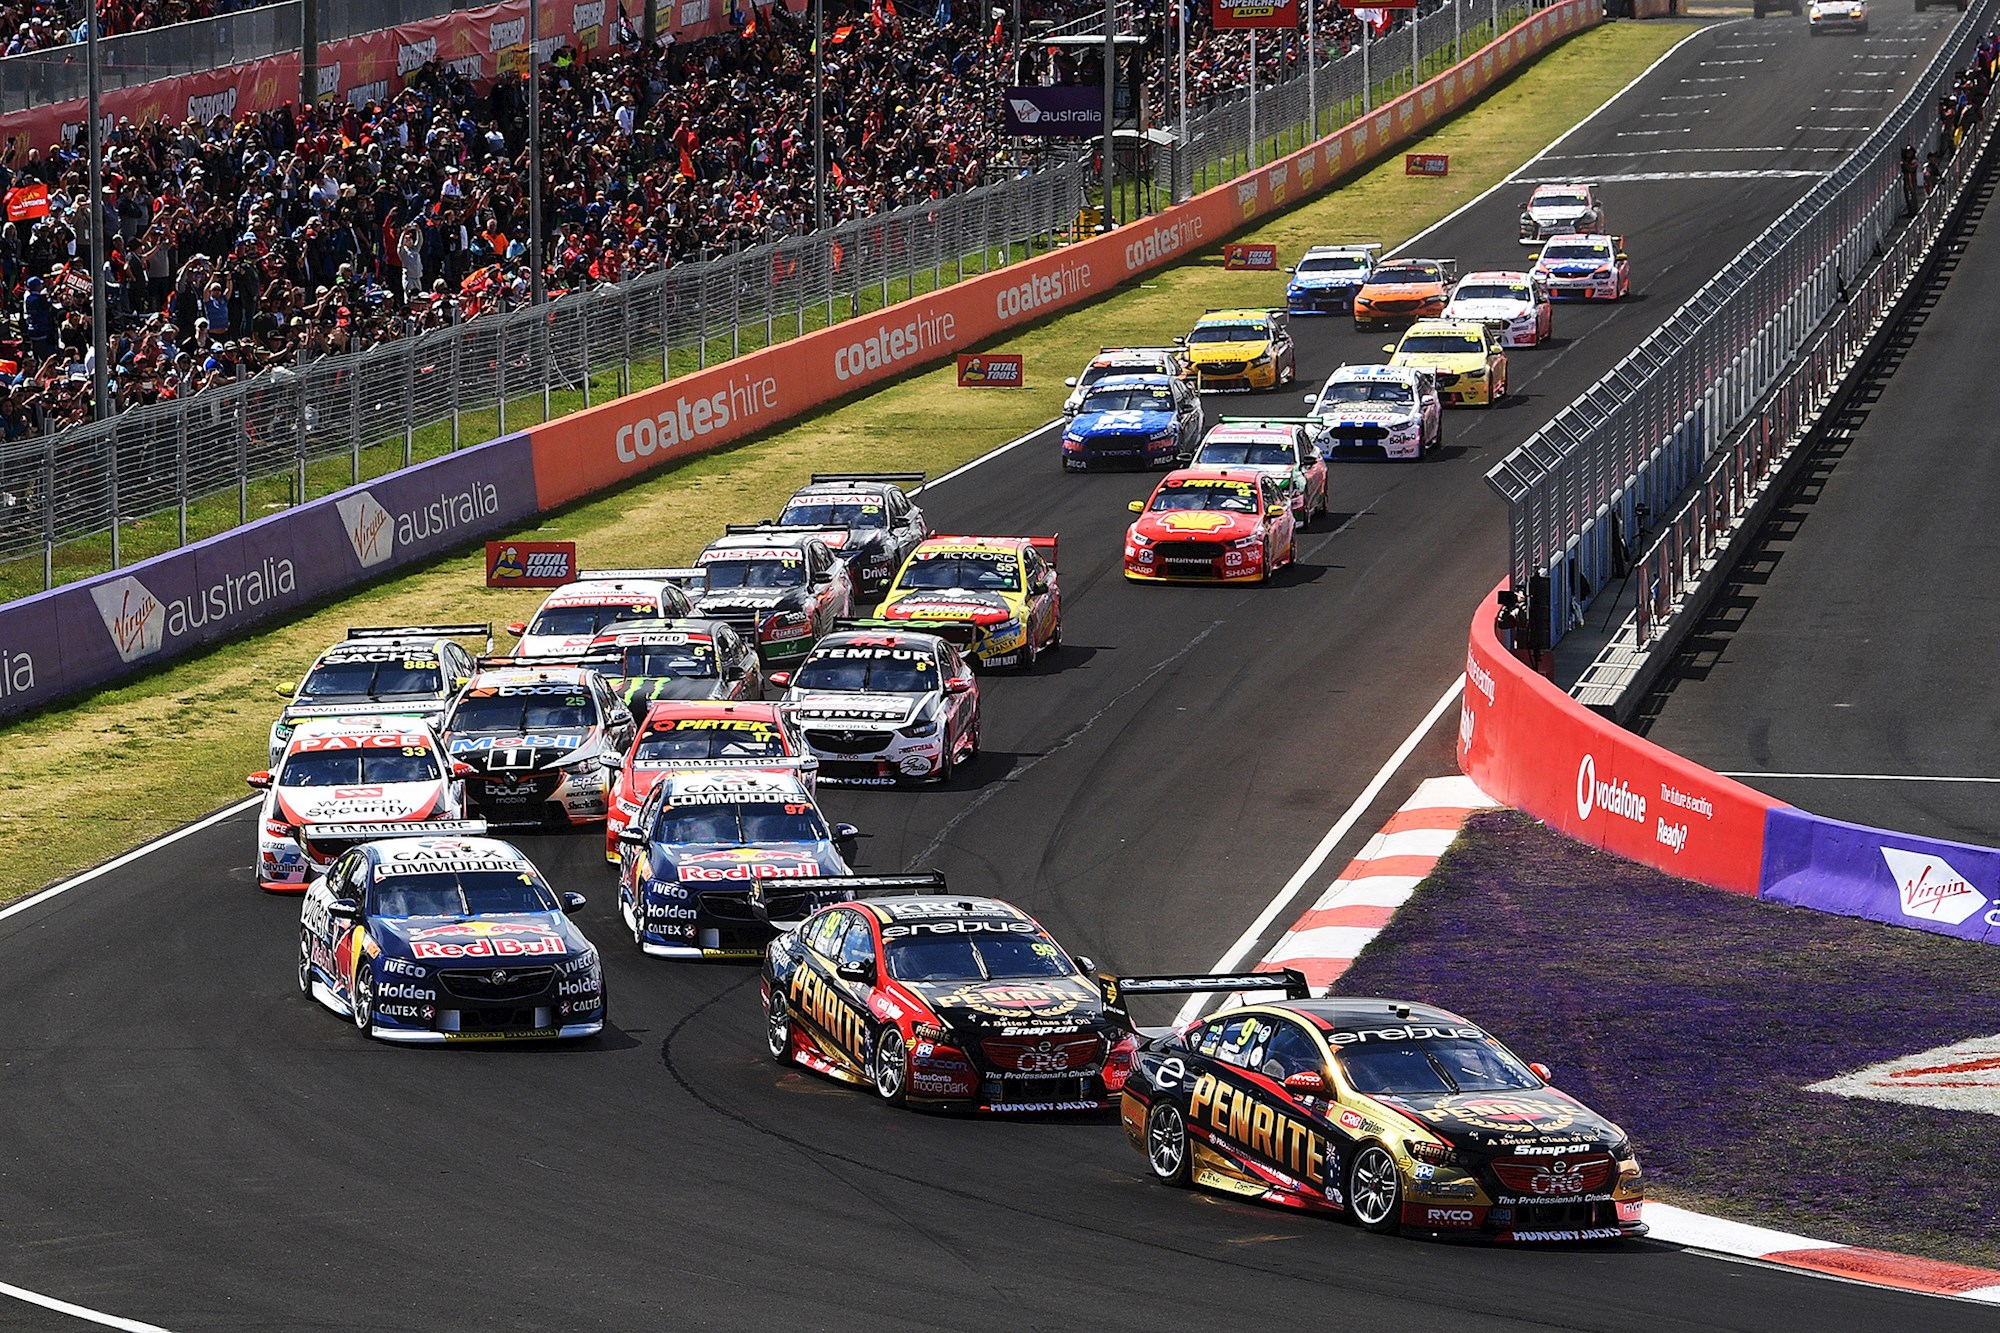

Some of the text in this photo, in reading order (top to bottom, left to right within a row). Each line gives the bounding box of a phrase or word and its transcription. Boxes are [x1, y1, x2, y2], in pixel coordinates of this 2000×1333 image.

[1041, 109, 1102, 122] australia
[1248, 250, 1273, 259] TOTAL
[987, 362, 1018, 371] TOTAL
[987, 371, 1018, 380] TOOLS
[1340, 413, 1393, 421] Castrol
[1182, 479, 1250, 489] PIRTEK
[793, 496, 880, 504] NISSAN
[861, 505, 879, 514] 23
[354, 481, 498, 561] Virgin australia
[526, 552, 569, 566] TOTAL
[704, 550, 798, 559] NISSAN
[941, 552, 1017, 562] TICKFORD
[781, 560, 796, 568] 11
[996, 563, 1014, 572] 55
[1129, 563, 1153, 574] SHARP
[525, 565, 569, 578] TOOLS
[1225, 567, 1256, 577] SHARP
[114, 556, 295, 653] Virgin australia
[548, 598, 604, 607] PAYNTER
[903, 597, 998, 606] NAVY HEALTH
[631, 605, 653, 613] 34
[895, 604, 1000, 615] SUPERCHEAP
[331, 645, 432, 655] mtaa super
[693, 647, 705, 656] 6
[814, 648, 932, 660] TEMPUR
[323, 652, 435, 665] SACHS
[983, 657, 1002, 667] TEAM
[916, 662, 927, 672] 8
[498, 685, 584, 697] boost
[311, 702, 438, 714] Wilson Security
[565, 696, 587, 707] 25
[675, 719, 773, 732] PIRTEK
[299, 735, 421, 751] PAYCE
[450, 734, 582, 754] Mobil
[752, 732, 773, 743] 17
[401, 747, 427, 757] 33
[502, 749, 518, 766] 1
[316, 798, 401, 807] Wilson
[495, 796, 527, 805] mobile
[668, 793, 808, 806] COMMODORE
[1595, 777, 1647, 824] vodafone
[1660, 783, 1670, 803] The
[1670, 787, 1686, 810] future
[1685, 792, 1692, 811] is
[306, 805, 409, 818] Security
[784, 804, 806, 815] 97
[315, 821, 473, 834] COMMODORE
[1656, 817, 1688, 855] Ready?
[377, 859, 527, 876] COMMODORE
[678, 862, 818, 882] Red Bull
[517, 873, 533, 886] 1
[652, 881, 689, 900] IVECO
[1904, 865, 1972, 914] Virgin
[647, 903, 697, 920] Holden
[647, 922, 682, 936] CALTEX
[821, 911, 843, 938] 99
[882, 919, 1035, 937] erebus
[409, 936, 568, 959] Red Bull
[1030, 942, 1059, 957] 99
[383, 959, 427, 979] IVECO
[377, 982, 437, 1001] Holden
[558, 976, 602, 996] Holden
[572, 997, 602, 1012] CALTEX
[935, 990, 1095, 1009] PENRITE
[378, 1004, 418, 1018] CALTEX
[789, 960, 866, 1063] PENRITE
[980, 1020, 991, 1028] A
[992, 1019, 1028, 1028] Better
[1029, 1018, 1056, 1027] Class
[1073, 1017, 1091, 1026] Oil
[445, 1030, 502, 1040] NATIONAL
[915, 1024, 951, 1043] PENRITE
[1000, 1025, 1079, 1037] Snap-on
[1236, 1017, 1258, 1047] 9
[1327, 1024, 1485, 1045] erebus
[917, 1044, 932, 1056] PPG
[1495, 1050, 1515, 1066] 9
[985, 1068, 1096, 1081] The Professional's Choice
[1292, 1074, 1321, 1082] RYCO
[990, 1102, 1054, 1112] HUNGRY
[1417, 1098, 1588, 1122] PENRITE
[1189, 1071, 1325, 1185] PENRITE
[1487, 1138, 1498, 1146] A
[1500, 1136, 1537, 1146] Better
[1538, 1135, 1564, 1144] Class
[1412, 1142, 1458, 1163] PENRITE
[1513, 1143, 1590, 1156] Snap-on
[1415, 1165, 1435, 1178] PPG
[1497, 1192, 1612, 1205] The Professional's Choice
[1427, 1208, 1474, 1221] RYCO
[1512, 1229, 1580, 1242] HUNGRY
